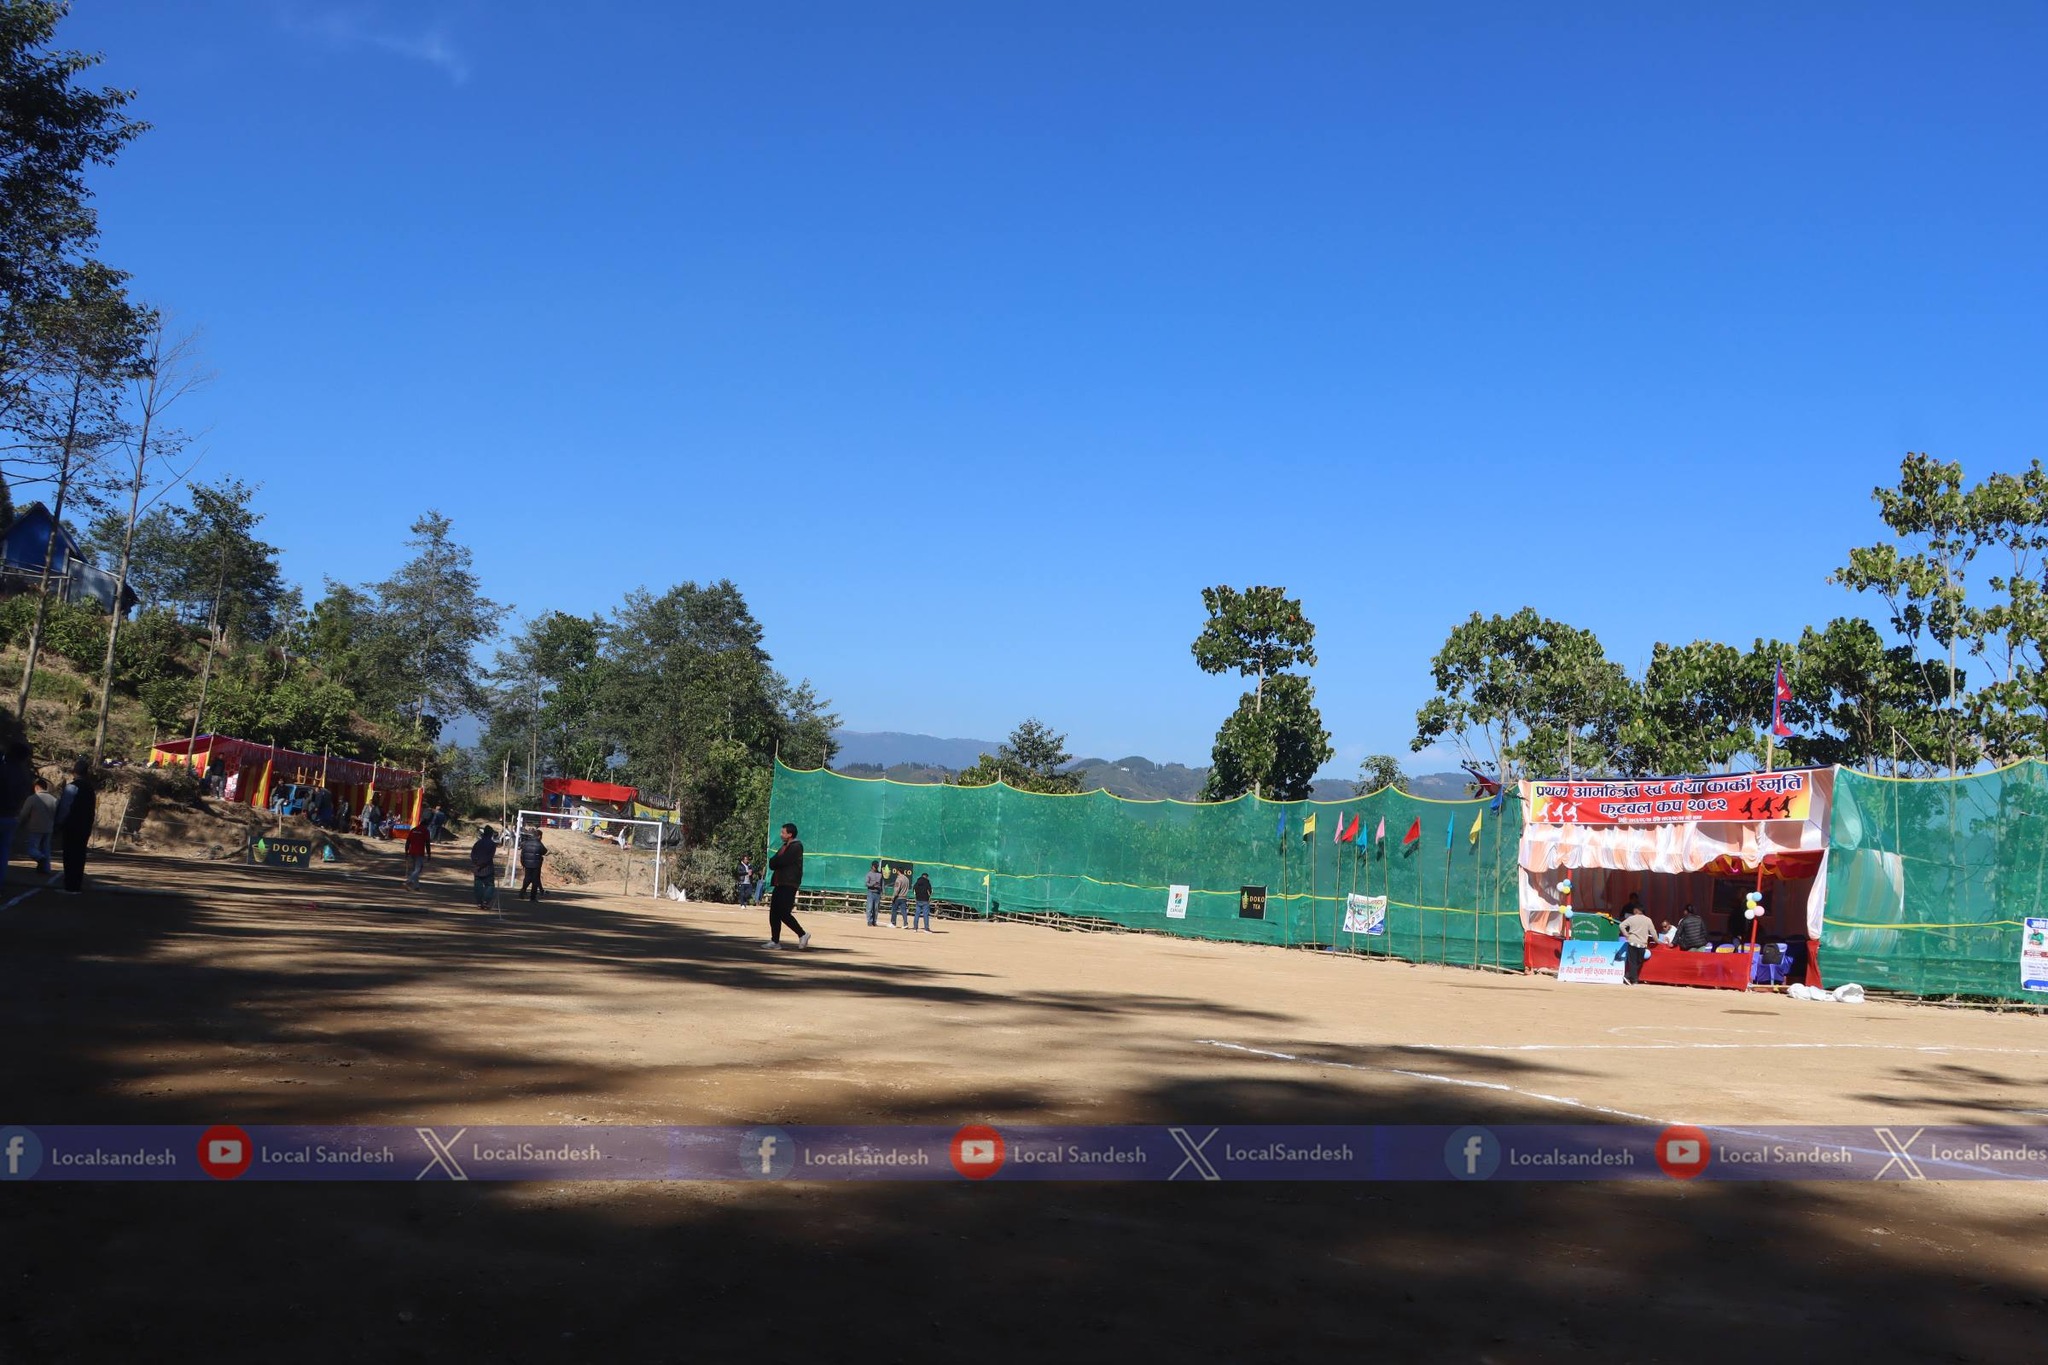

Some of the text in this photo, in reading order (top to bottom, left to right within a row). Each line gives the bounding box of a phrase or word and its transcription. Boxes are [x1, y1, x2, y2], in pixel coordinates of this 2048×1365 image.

[1536, 785, 1568, 798] प्रथम
[1574, 784, 1639, 798] आमन्त्रित
[1671, 781, 1703, 794] मैया
[1708, 776, 1752, 792] कार्की
[1757, 774, 1802, 792] स्मृति
[1600, 799, 1728, 817] फुटबल कप २०८२
[272, 843, 308, 854] DOKO
[281, 854, 298, 863] TEA
